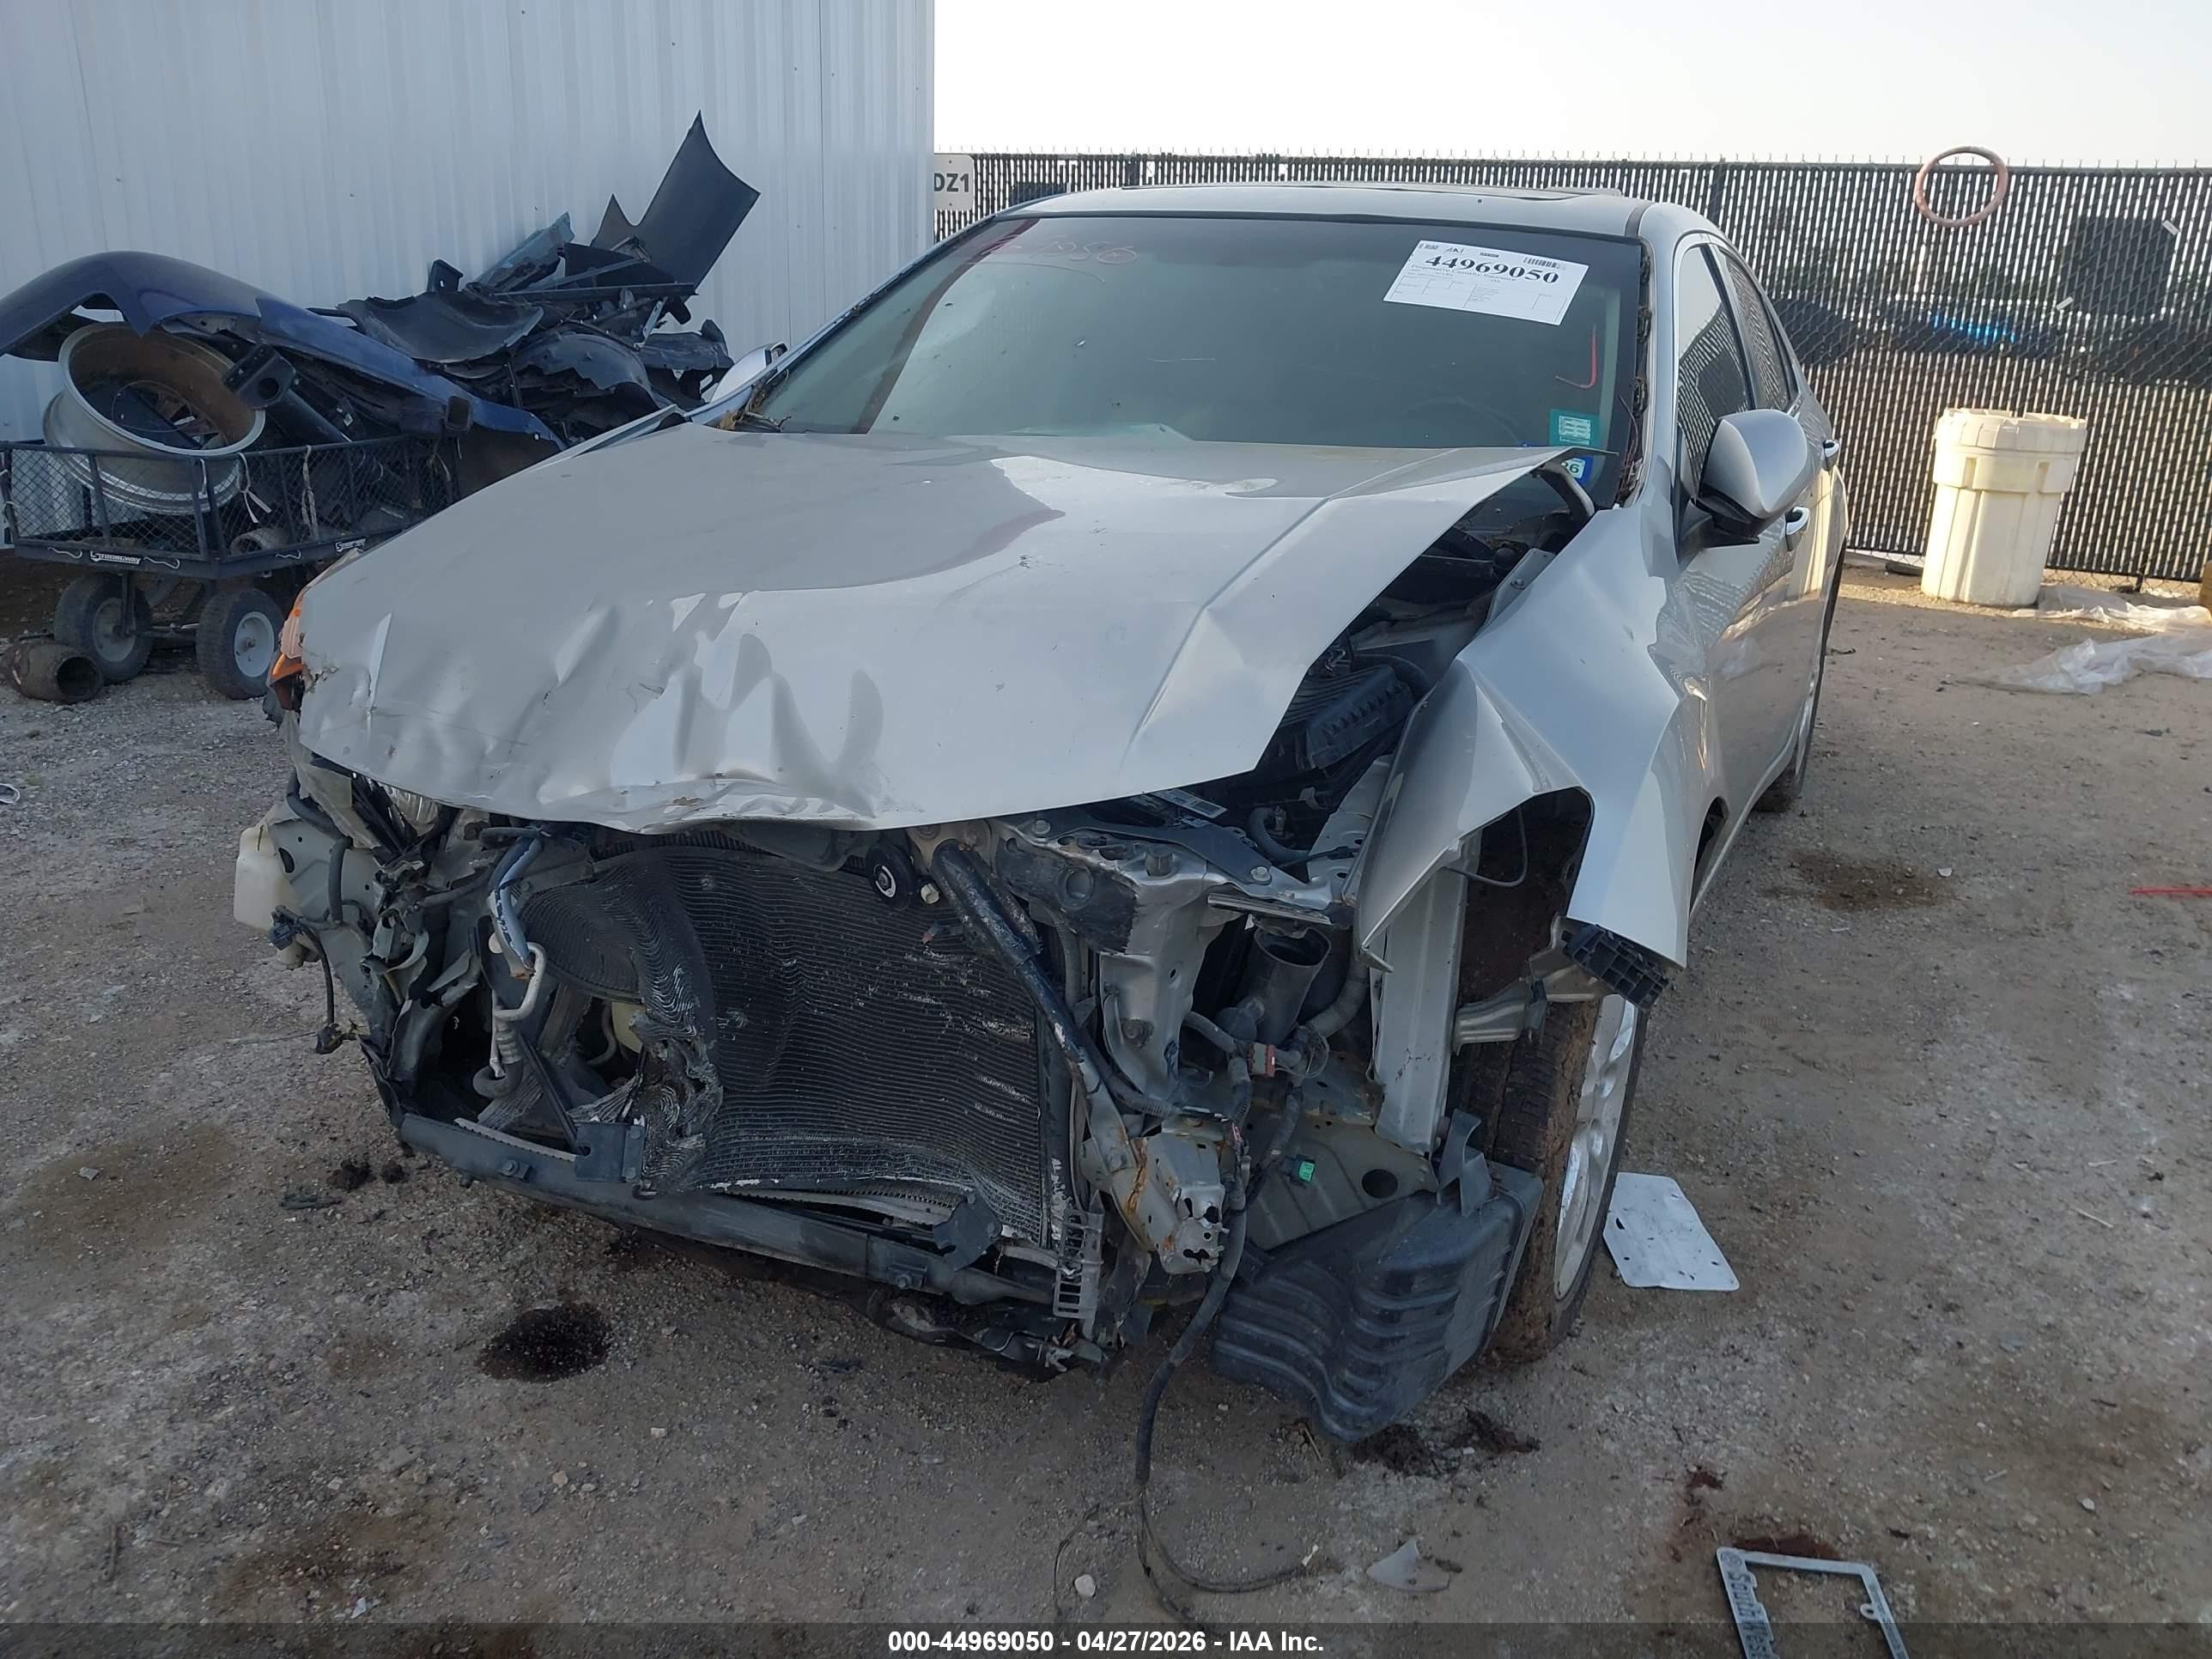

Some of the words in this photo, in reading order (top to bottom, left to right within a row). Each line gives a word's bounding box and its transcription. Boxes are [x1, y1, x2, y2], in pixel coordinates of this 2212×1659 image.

[934, 173, 969, 192] DZ1
[1425, 255, 1559, 284] 44969050
[90, 550, 141, 565] STRONGWAY
